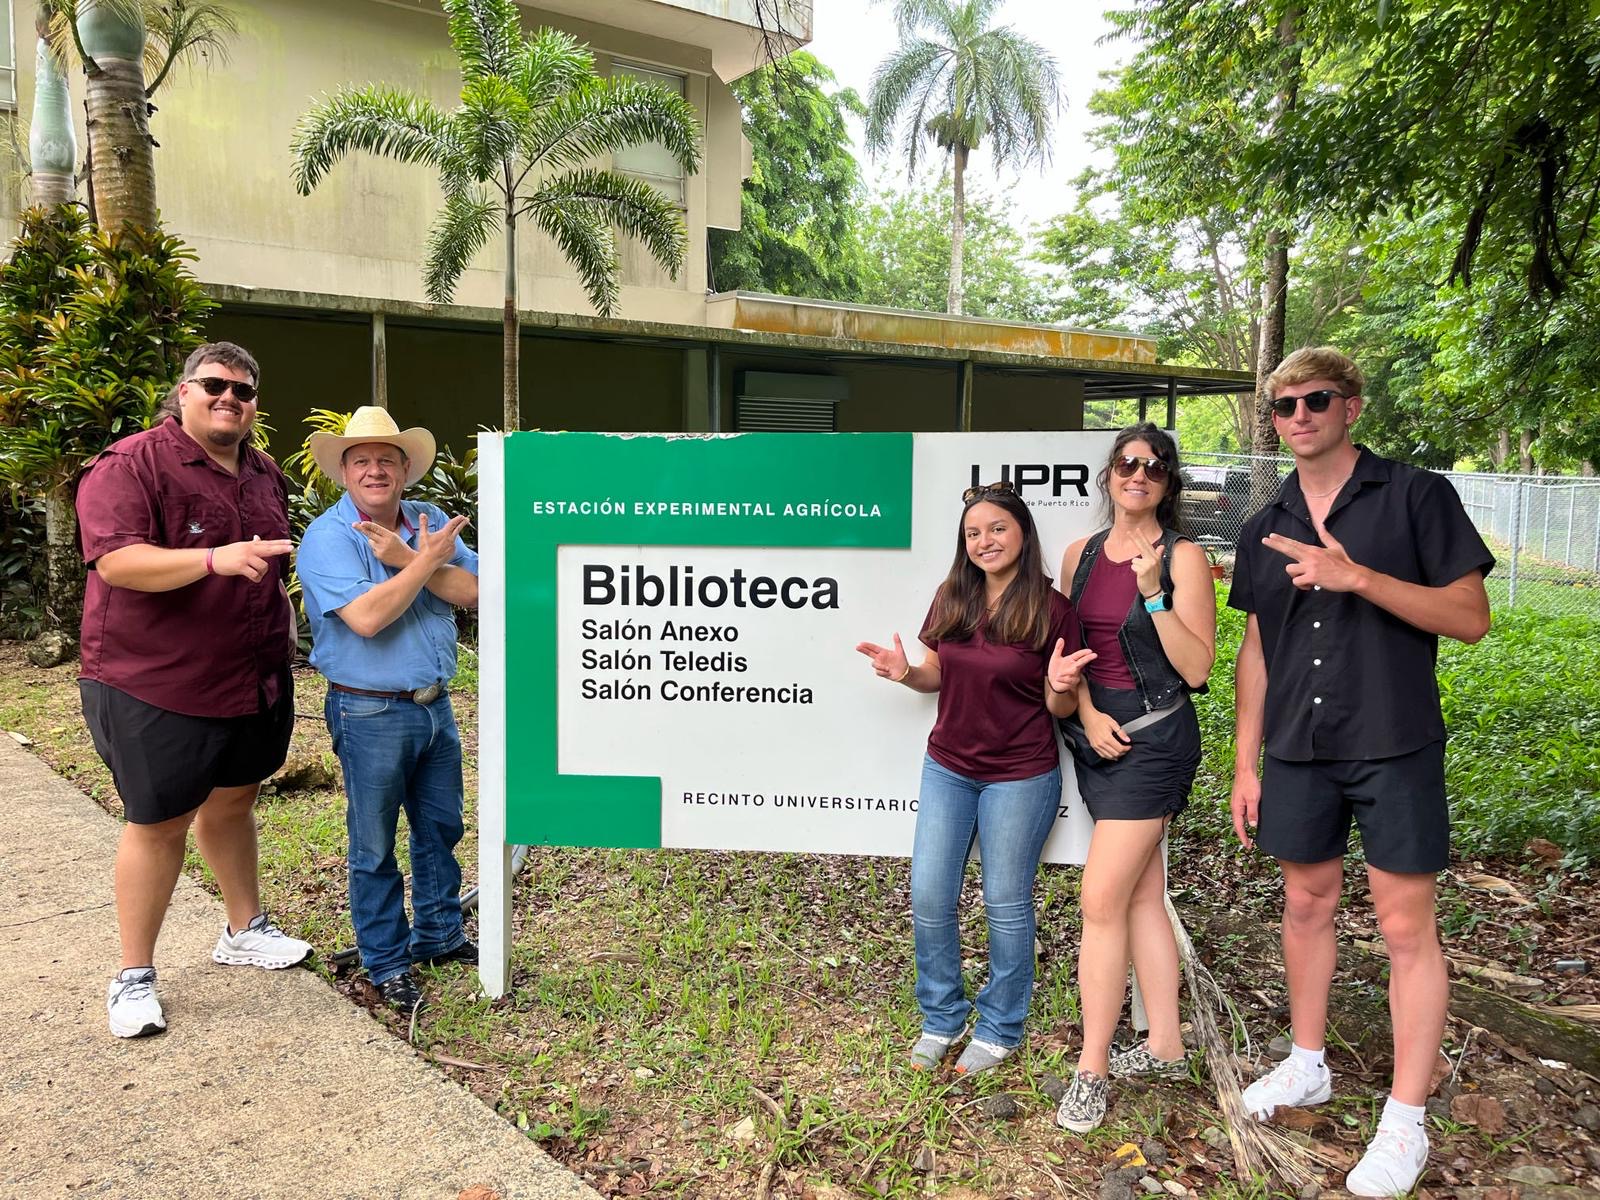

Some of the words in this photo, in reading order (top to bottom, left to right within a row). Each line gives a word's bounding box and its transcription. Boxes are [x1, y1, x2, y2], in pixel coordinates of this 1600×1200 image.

[533, 496, 625, 515] ESTACIÓN
[634, 502, 776, 516] EXPERIMENTAL
[783, 498, 881, 517] AGRÍCOLA
[1026, 499, 1036, 508] de
[1037, 499, 1068, 508] Puerto
[1069, 499, 1090, 508] Rico
[583, 564, 840, 610] Biblioteca
[581, 618, 652, 641] Salón
[659, 620, 739, 643] Anexo
[581, 648, 652, 672] Salón
[659, 650, 748, 673] Teledis
[581, 678, 652, 701] Salón
[660, 679, 813, 705] Conferencia
[683, 792, 765, 807] RECINTO
[774, 795, 920, 812] UNIVERSITARIO
